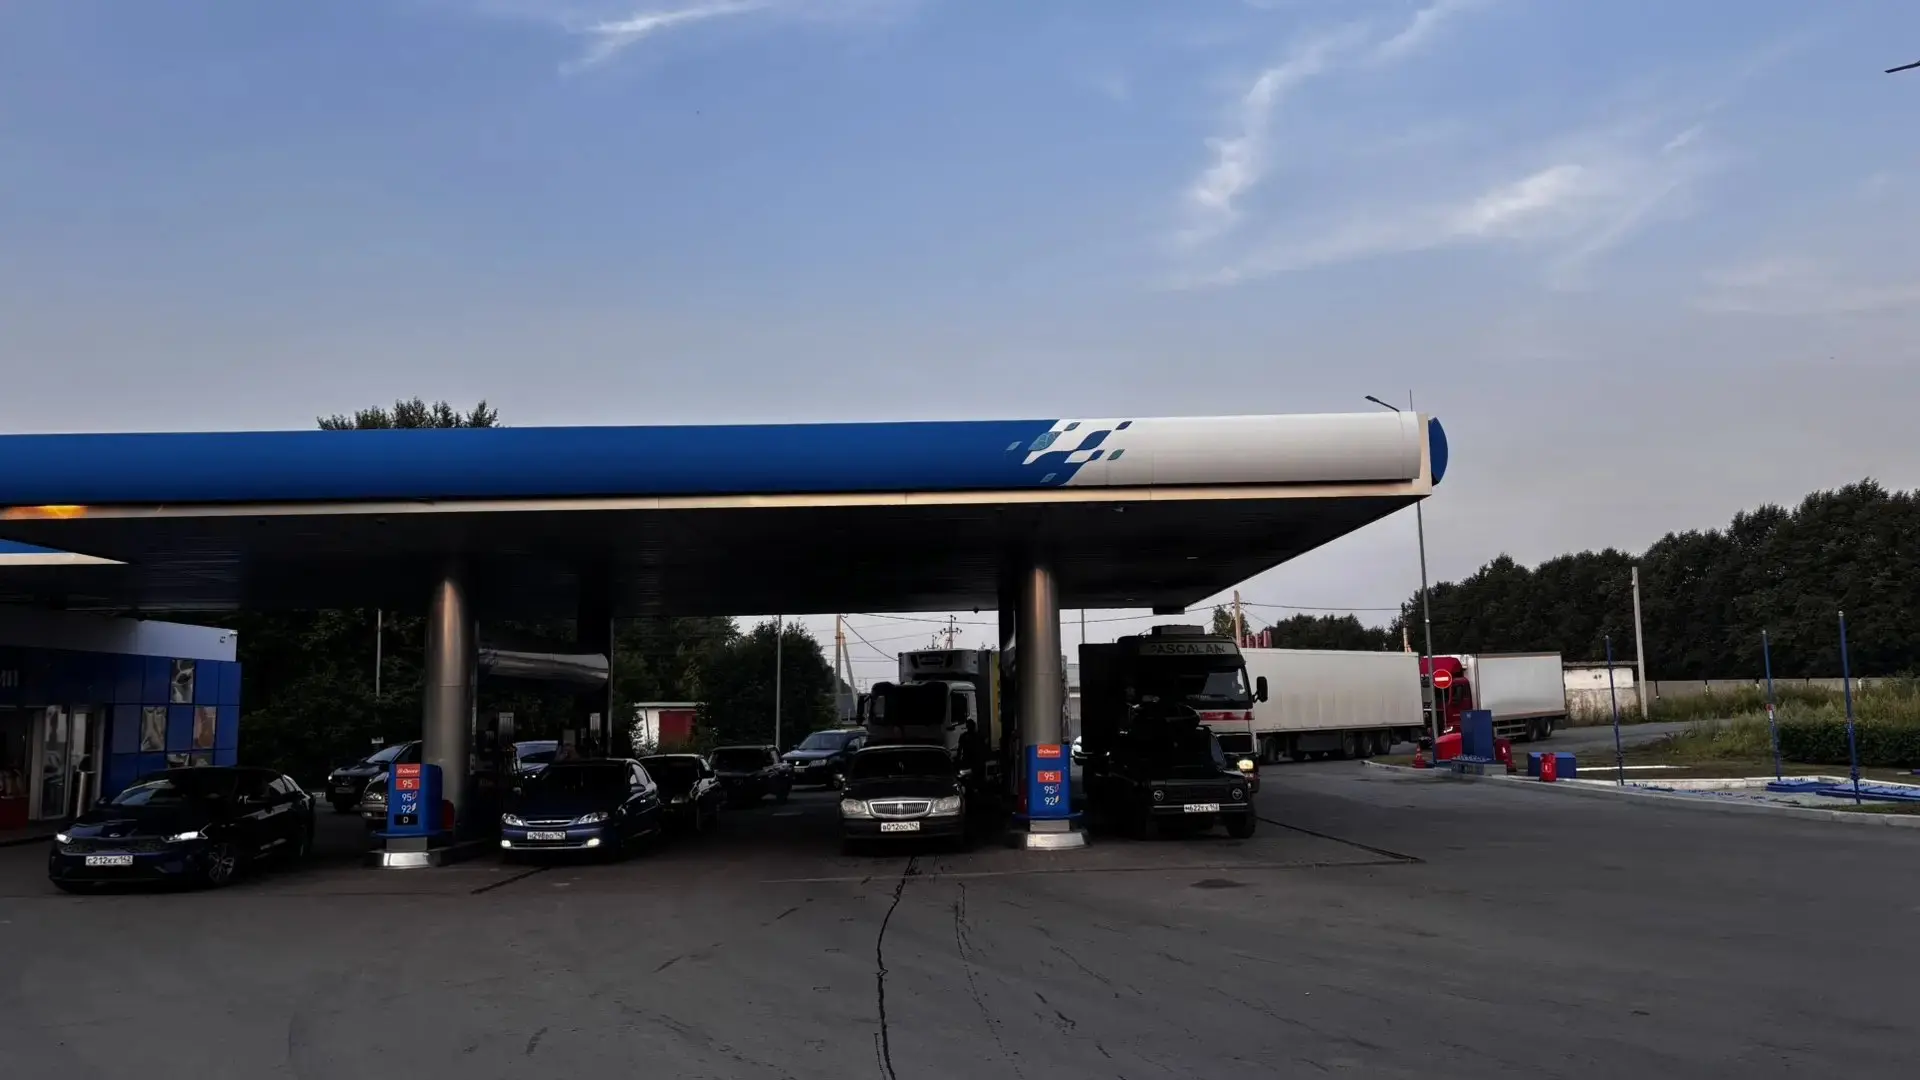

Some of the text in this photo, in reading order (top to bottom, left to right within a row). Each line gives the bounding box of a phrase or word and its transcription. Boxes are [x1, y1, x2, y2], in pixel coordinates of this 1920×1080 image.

[1043, 772, 1055, 781] 95
[402, 779, 413, 788] 95
[1043, 785, 1054, 795] 95
[401, 793, 412, 802] 95
[1044, 796, 1055, 806] 92
[401, 804, 411, 814] 92
[403, 816, 409, 824] D
